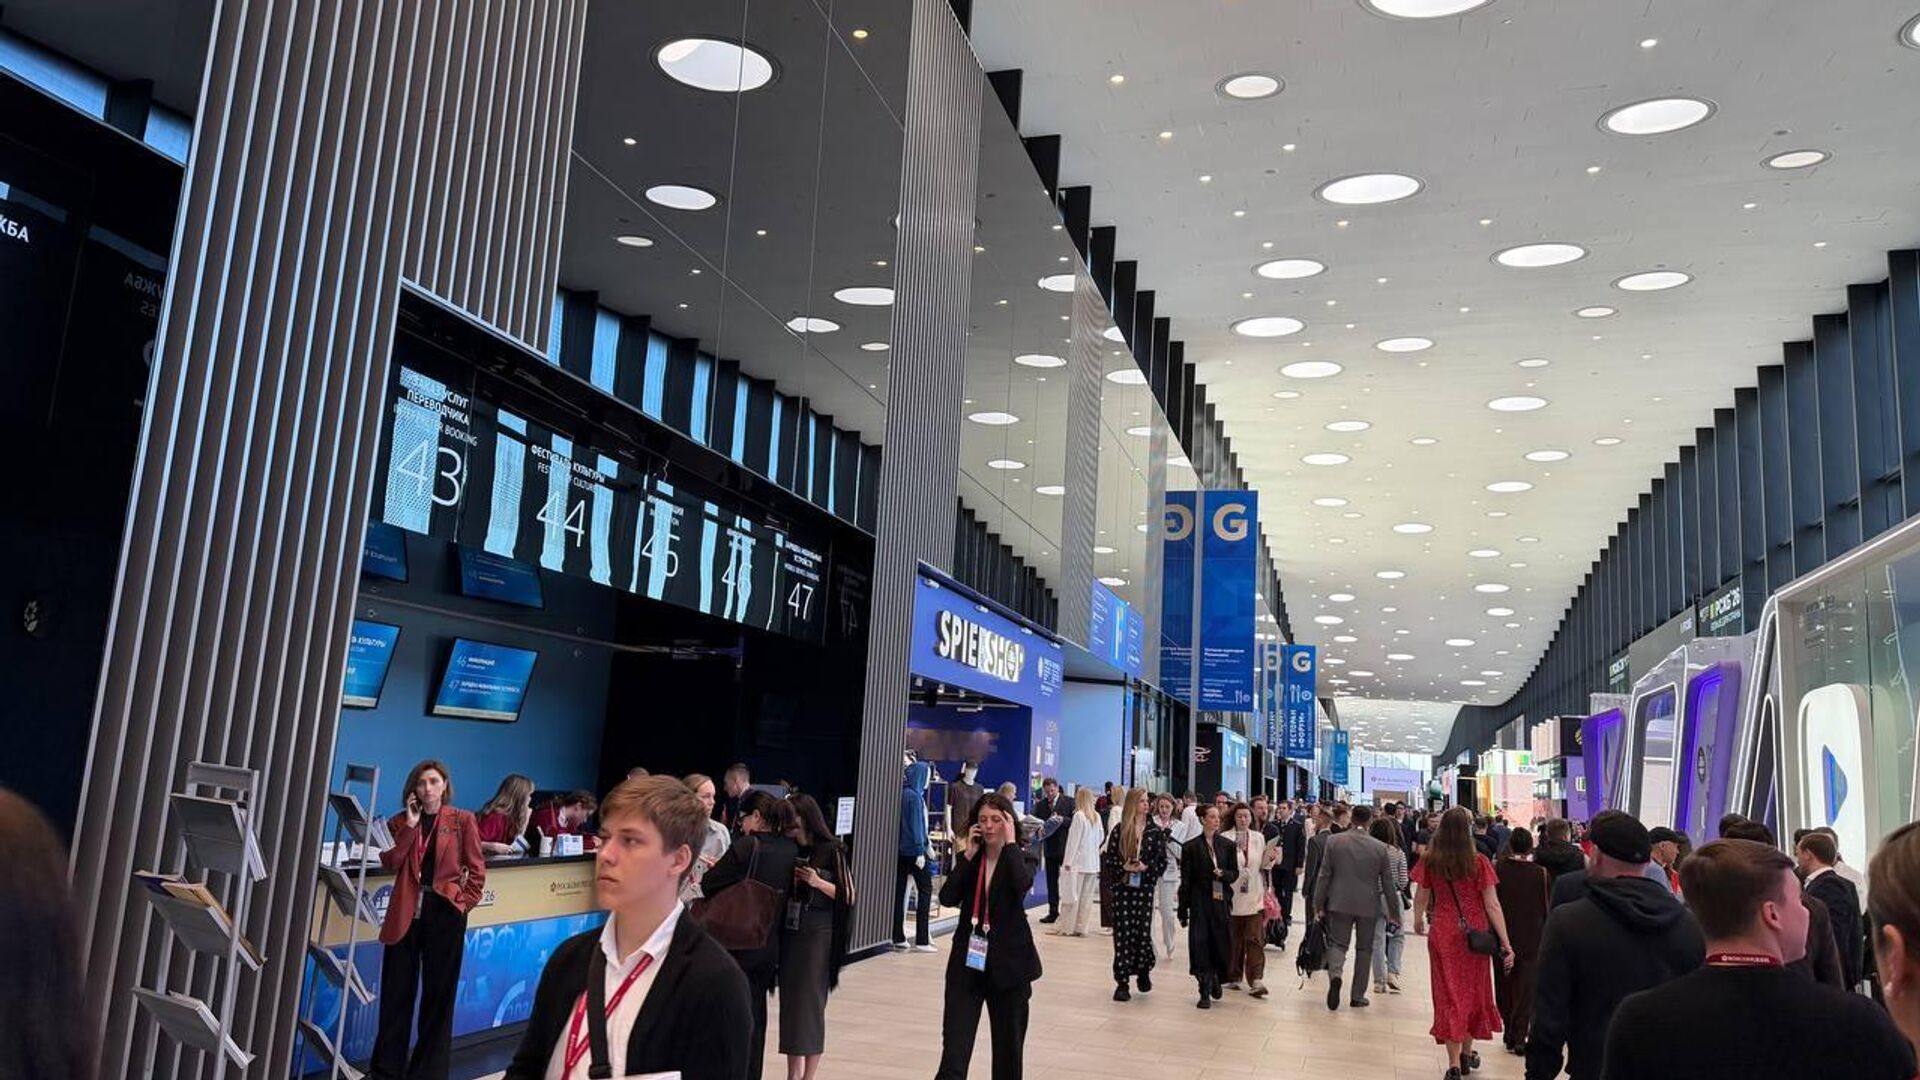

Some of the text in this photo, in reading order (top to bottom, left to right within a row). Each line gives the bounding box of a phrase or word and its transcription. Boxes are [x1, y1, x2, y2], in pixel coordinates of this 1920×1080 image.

[407, 389, 470, 426] ПЕРЕВОДЧИКА
[445, 424, 478, 447] BOOKING
[397, 439, 462, 507] 43
[536, 490, 585, 547] 44
[1212, 503, 1249, 542] G
[641, 532, 681, 578] 45
[788, 582, 814, 620] 47
[1292, 652, 1311, 672] G
[1289, 709, 1297, 747] РЕСТОРАН
